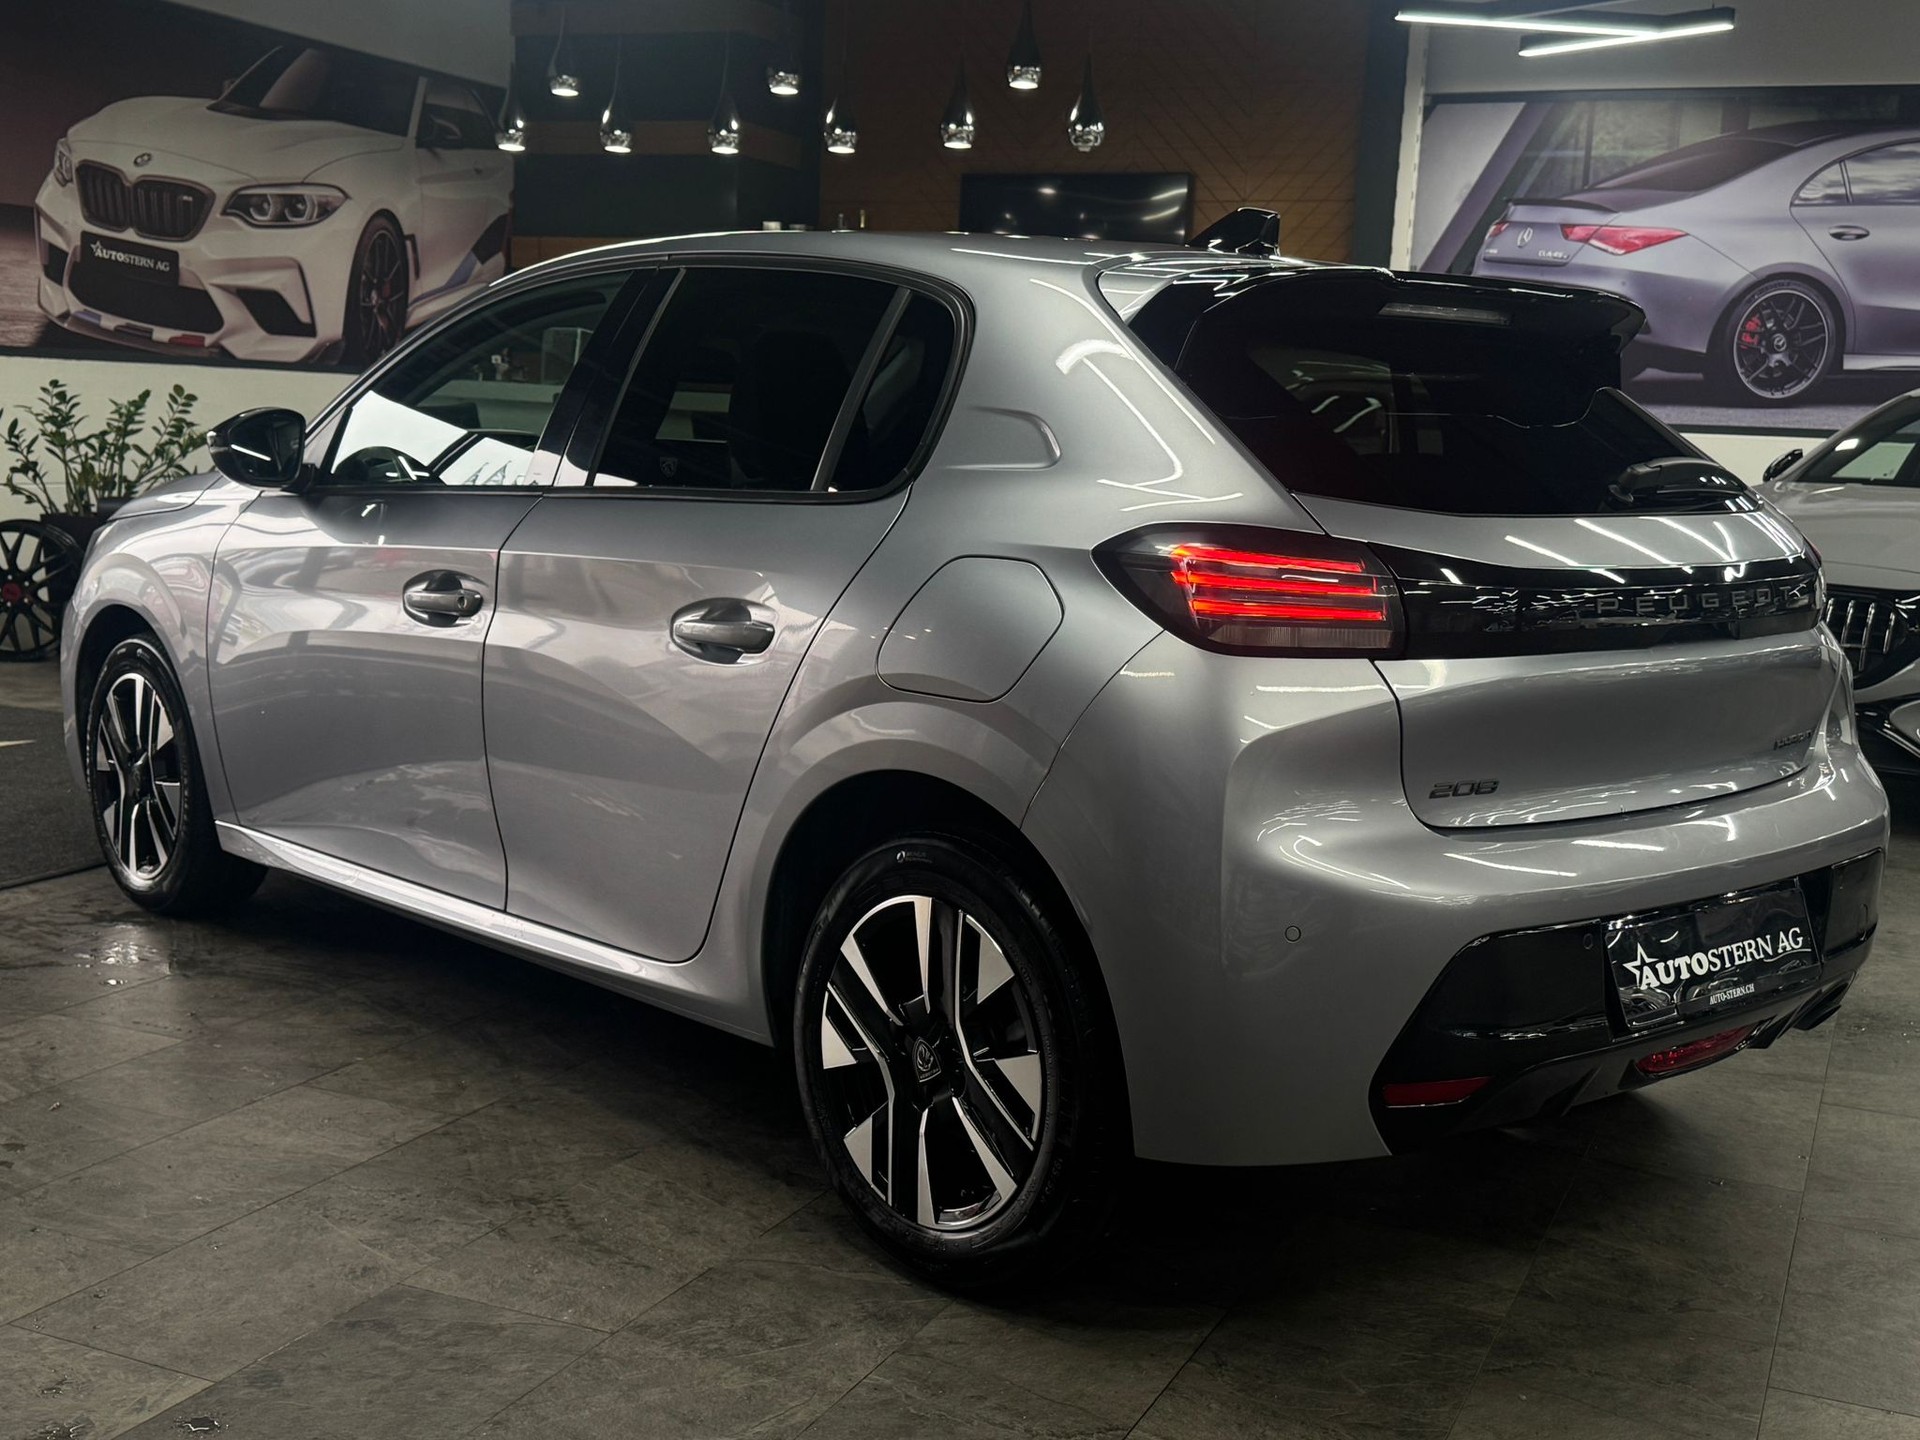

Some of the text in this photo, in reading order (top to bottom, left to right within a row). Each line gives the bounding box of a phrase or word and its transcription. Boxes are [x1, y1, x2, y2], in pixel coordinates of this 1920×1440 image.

[94, 247, 170, 272] AUTOSTERN AG
[1597, 585, 1792, 613] PEUGEOT
[1429, 780, 1499, 799] 208
[1640, 927, 1803, 990] AUTOSTERN AG
[1709, 983, 1755, 1005] AUTO-STERN.CH
